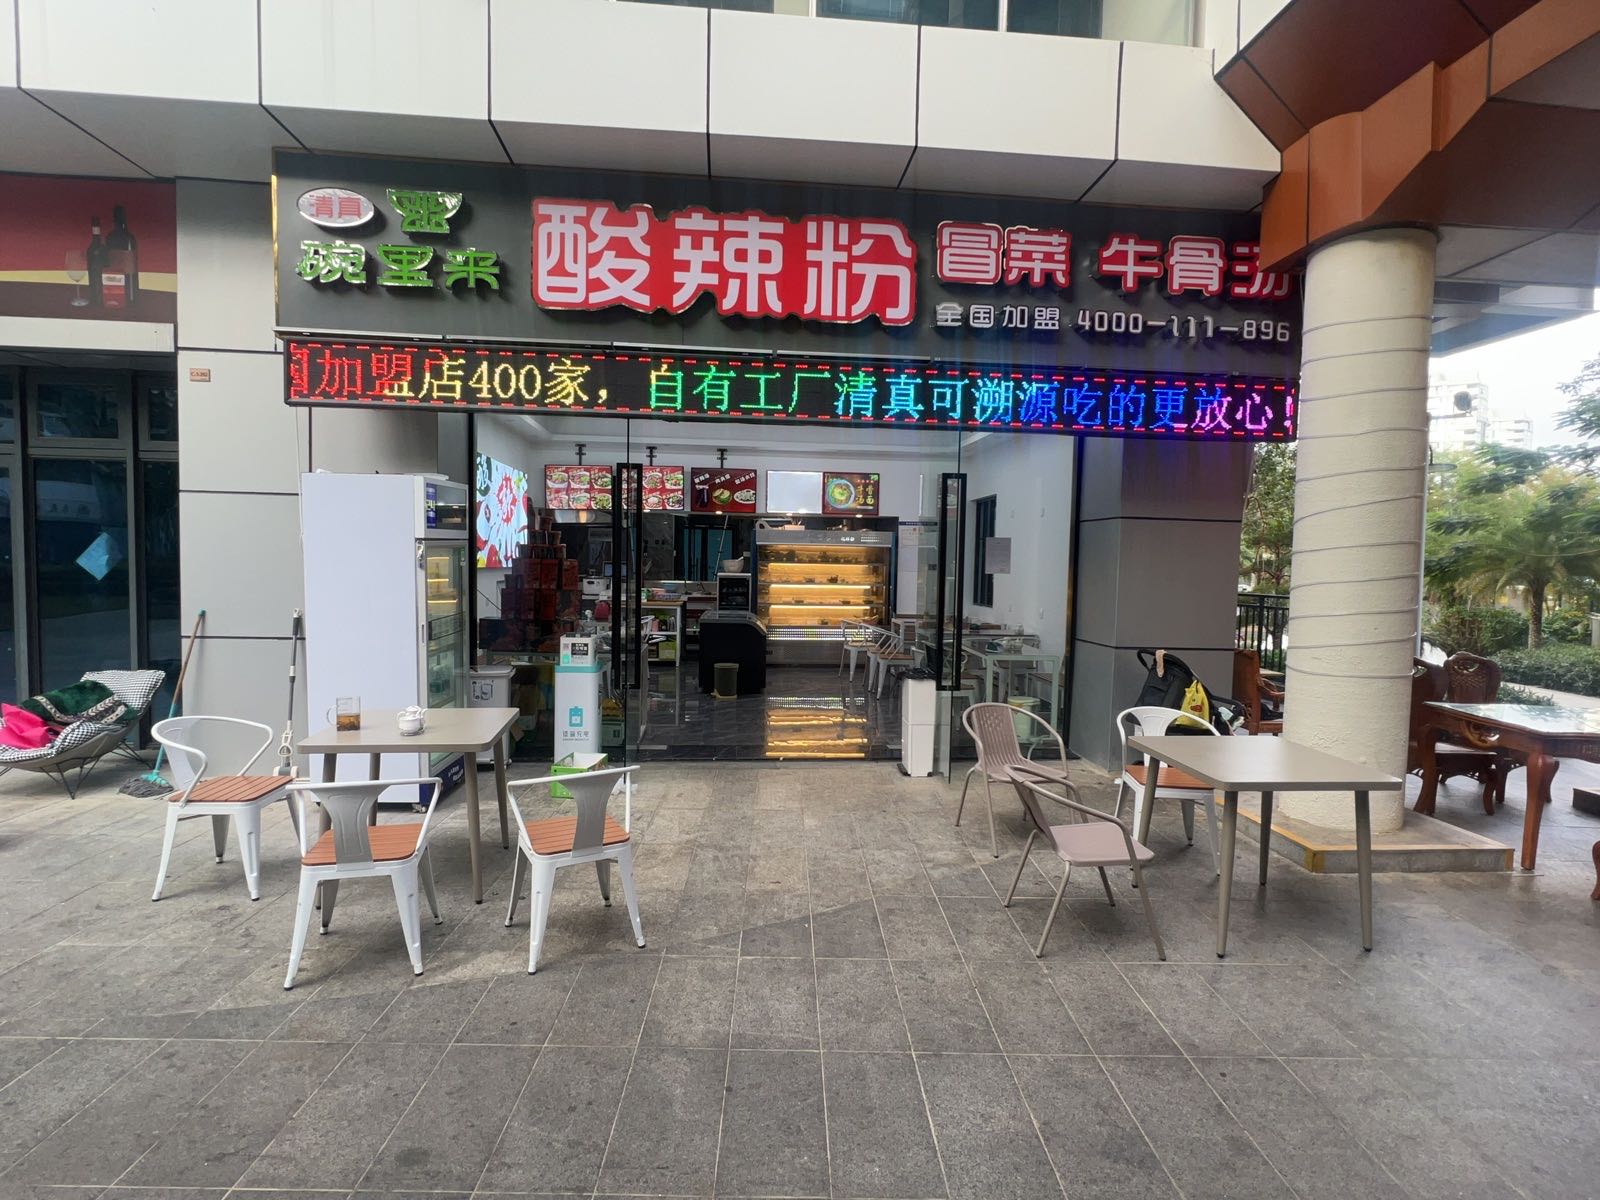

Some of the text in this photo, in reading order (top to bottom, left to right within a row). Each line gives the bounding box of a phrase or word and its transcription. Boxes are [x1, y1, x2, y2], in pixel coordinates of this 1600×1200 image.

[308, 194, 362, 219] 清真
[296, 240, 500, 289] 碗里来
[537, 203, 912, 319] 酸辣粉
[941, 226, 1068, 285] 冒菜
[935, 302, 1060, 331] 全国加盟
